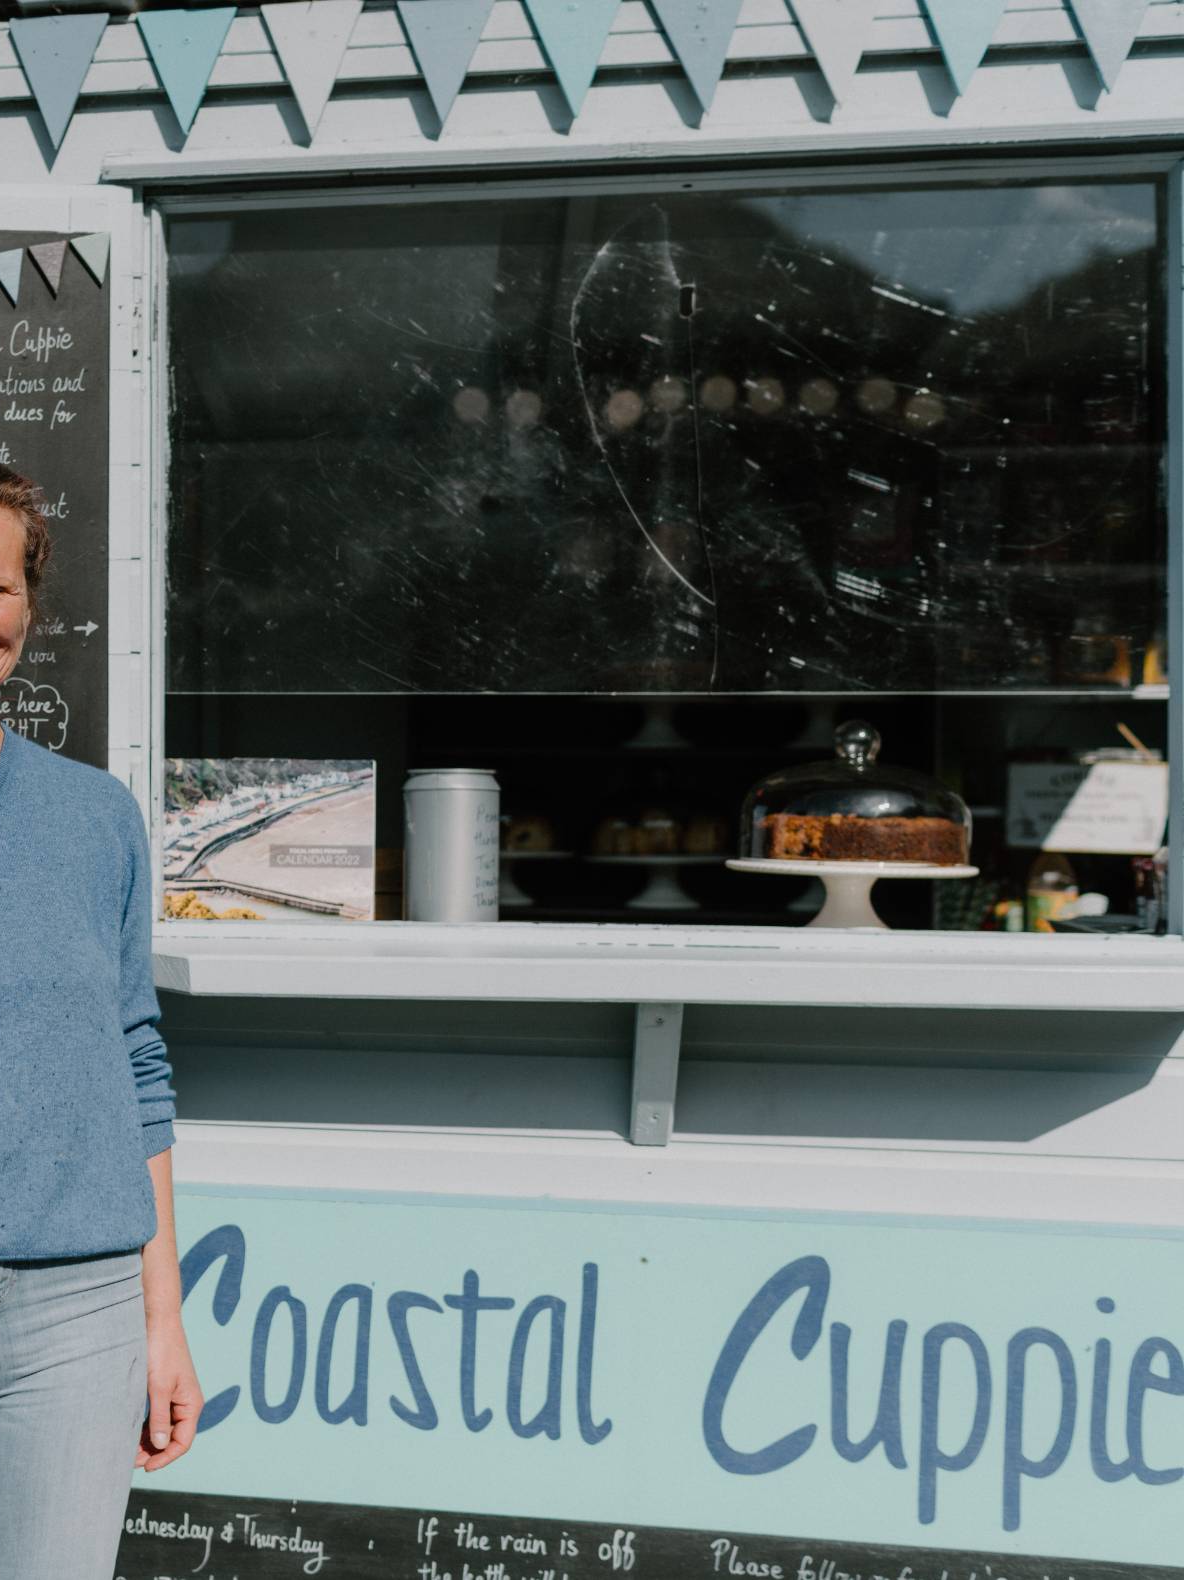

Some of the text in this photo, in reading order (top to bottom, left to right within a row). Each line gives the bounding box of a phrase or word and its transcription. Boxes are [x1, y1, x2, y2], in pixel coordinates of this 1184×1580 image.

[10, 320, 74, 363] Cuppie
[53, 368, 86, 392] and
[4, 401, 44, 421] dues
[50, 400, 77, 430] for
[35, 617, 66, 635] side
[28, 651, 57, 671] you
[17, 691, 55, 713] here
[276, 854, 360, 866] CALENDAR 2022
[179, 1224, 1184, 1532] Coastal Cuppie
[123, 1508, 214, 1573] ednesday
[236, 1513, 331, 1574] Thursday
[418, 1517, 636, 1570] If the rain is off
[710, 1538, 784, 1580] Please
